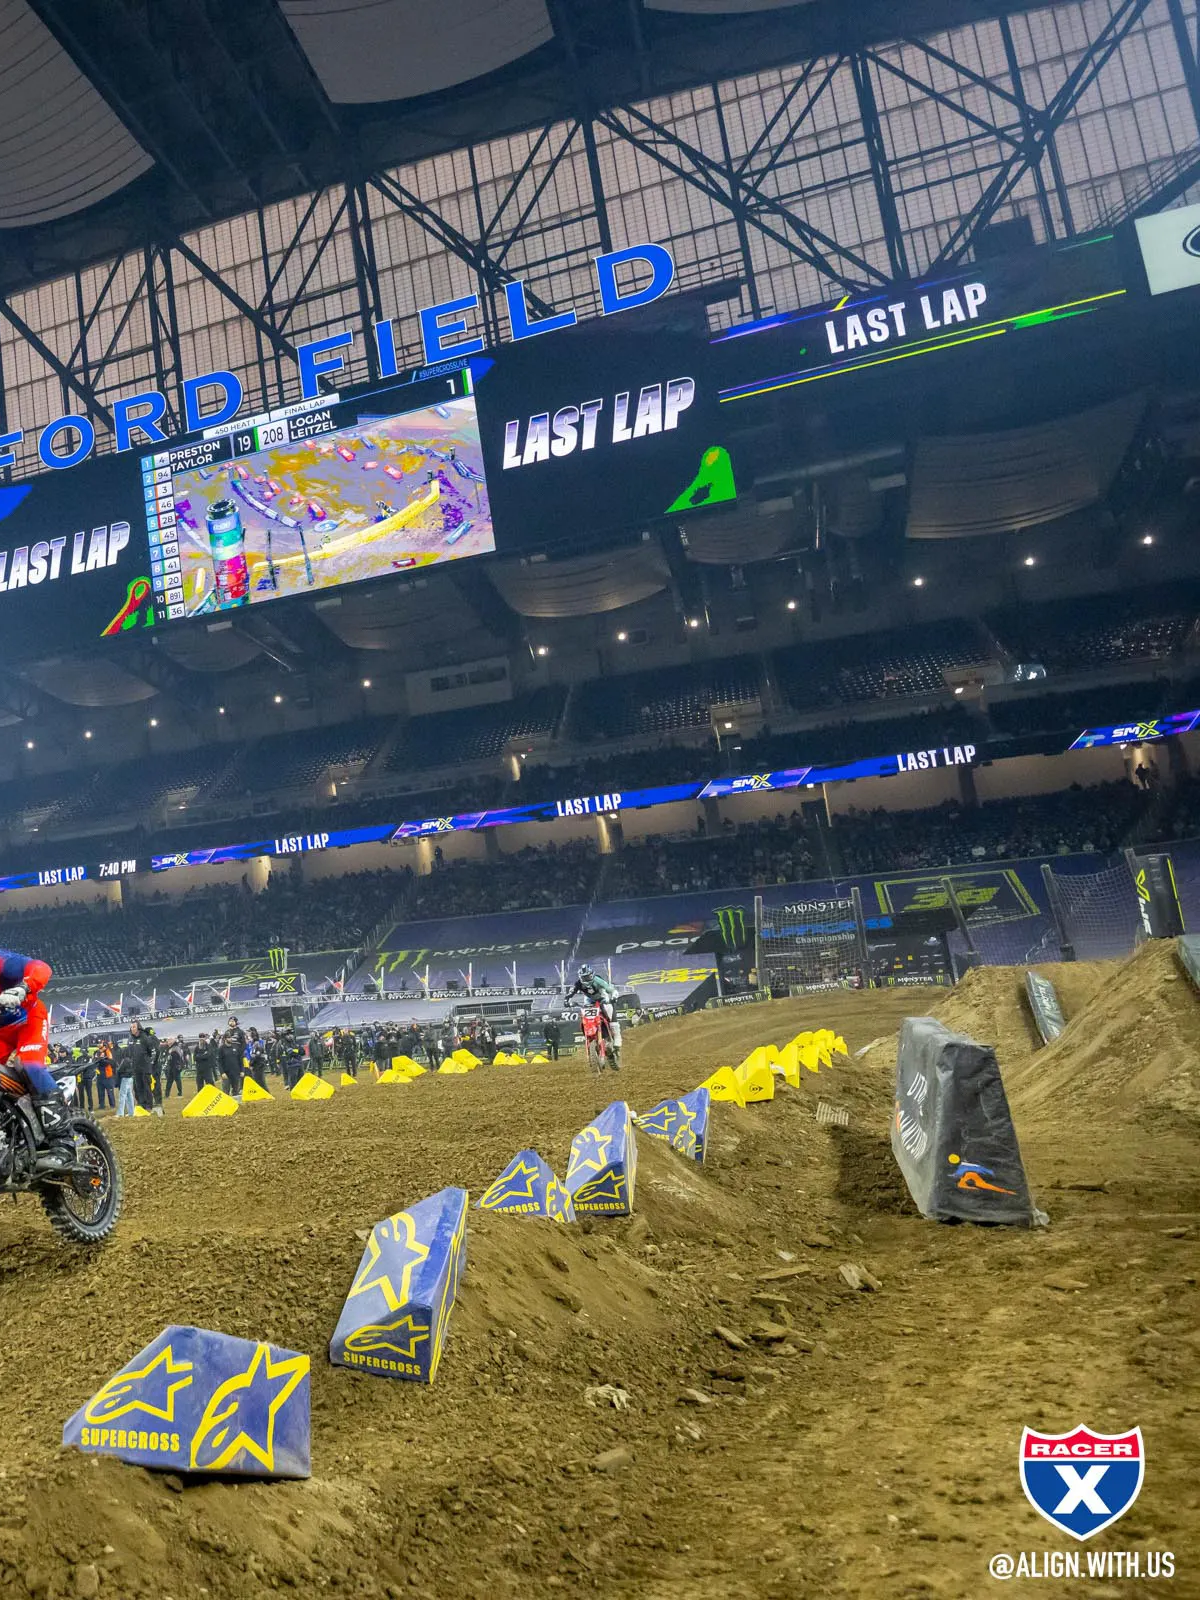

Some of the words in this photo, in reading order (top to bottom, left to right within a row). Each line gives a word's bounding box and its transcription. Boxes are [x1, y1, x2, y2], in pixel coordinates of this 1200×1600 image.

[297, 242, 675, 400] FIELD
[825, 302, 906, 354] LAST
[922, 282, 988, 329] LAP
[419, 358, 468, 379] #SUPERCROSSLIVE
[446, 379, 456, 395] 1
[284, 403, 308, 416] FINAL
[309, 398, 326, 411] LAP
[214, 426, 229, 436] 450
[230, 421, 251, 431] HEAT
[290, 410, 331, 429] LOGAN
[503, 398, 603, 470] LAST
[612, 376, 695, 444] LAP
[262, 426, 284, 445] 208
[291, 422, 337, 440] LEITZEL
[170, 441, 221, 463] PRESTON
[237, 435, 251, 452] 19
[171, 453, 213, 473] TAYLOR
[158, 471, 169, 480] 94
[161, 501, 172, 510] 46
[162, 516, 173, 525] 28
[164, 531, 175, 540] 45
[71, 521, 131, 573] LAP
[165, 546, 177, 555] 66
[167, 561, 177, 570] 41
[168, 575, 179, 585] 20
[169, 591, 181, 600] 891
[171, 606, 182, 616] 36
[1112, 720, 1160, 738] SMX
[897, 750, 939, 772] LAST
[943, 744, 976, 766] LAP
[732, 773, 772, 789] SMX
[556, 798, 591, 818] LAST
[594, 793, 623, 812] LAP
[421, 817, 454, 832] SMX
[274, 835, 304, 854] LAST
[307, 832, 330, 850] LAP
[99, 861, 119, 877] 7:40
[121, 859, 137, 874] PM
[161, 853, 189, 866] SMX
[38, 870, 63, 886] LAST
[65, 866, 85, 883] LAP
[795, 932, 856, 945] Championship
[258, 976, 297, 993] SMX
[203, 1092, 224, 1115] DUNLOP
[574, 1202, 625, 1211] SUPERCROSS
[343, 1351, 421, 1376] SUPERCROSS
[80, 1427, 180, 1453] SUPERCROSS
